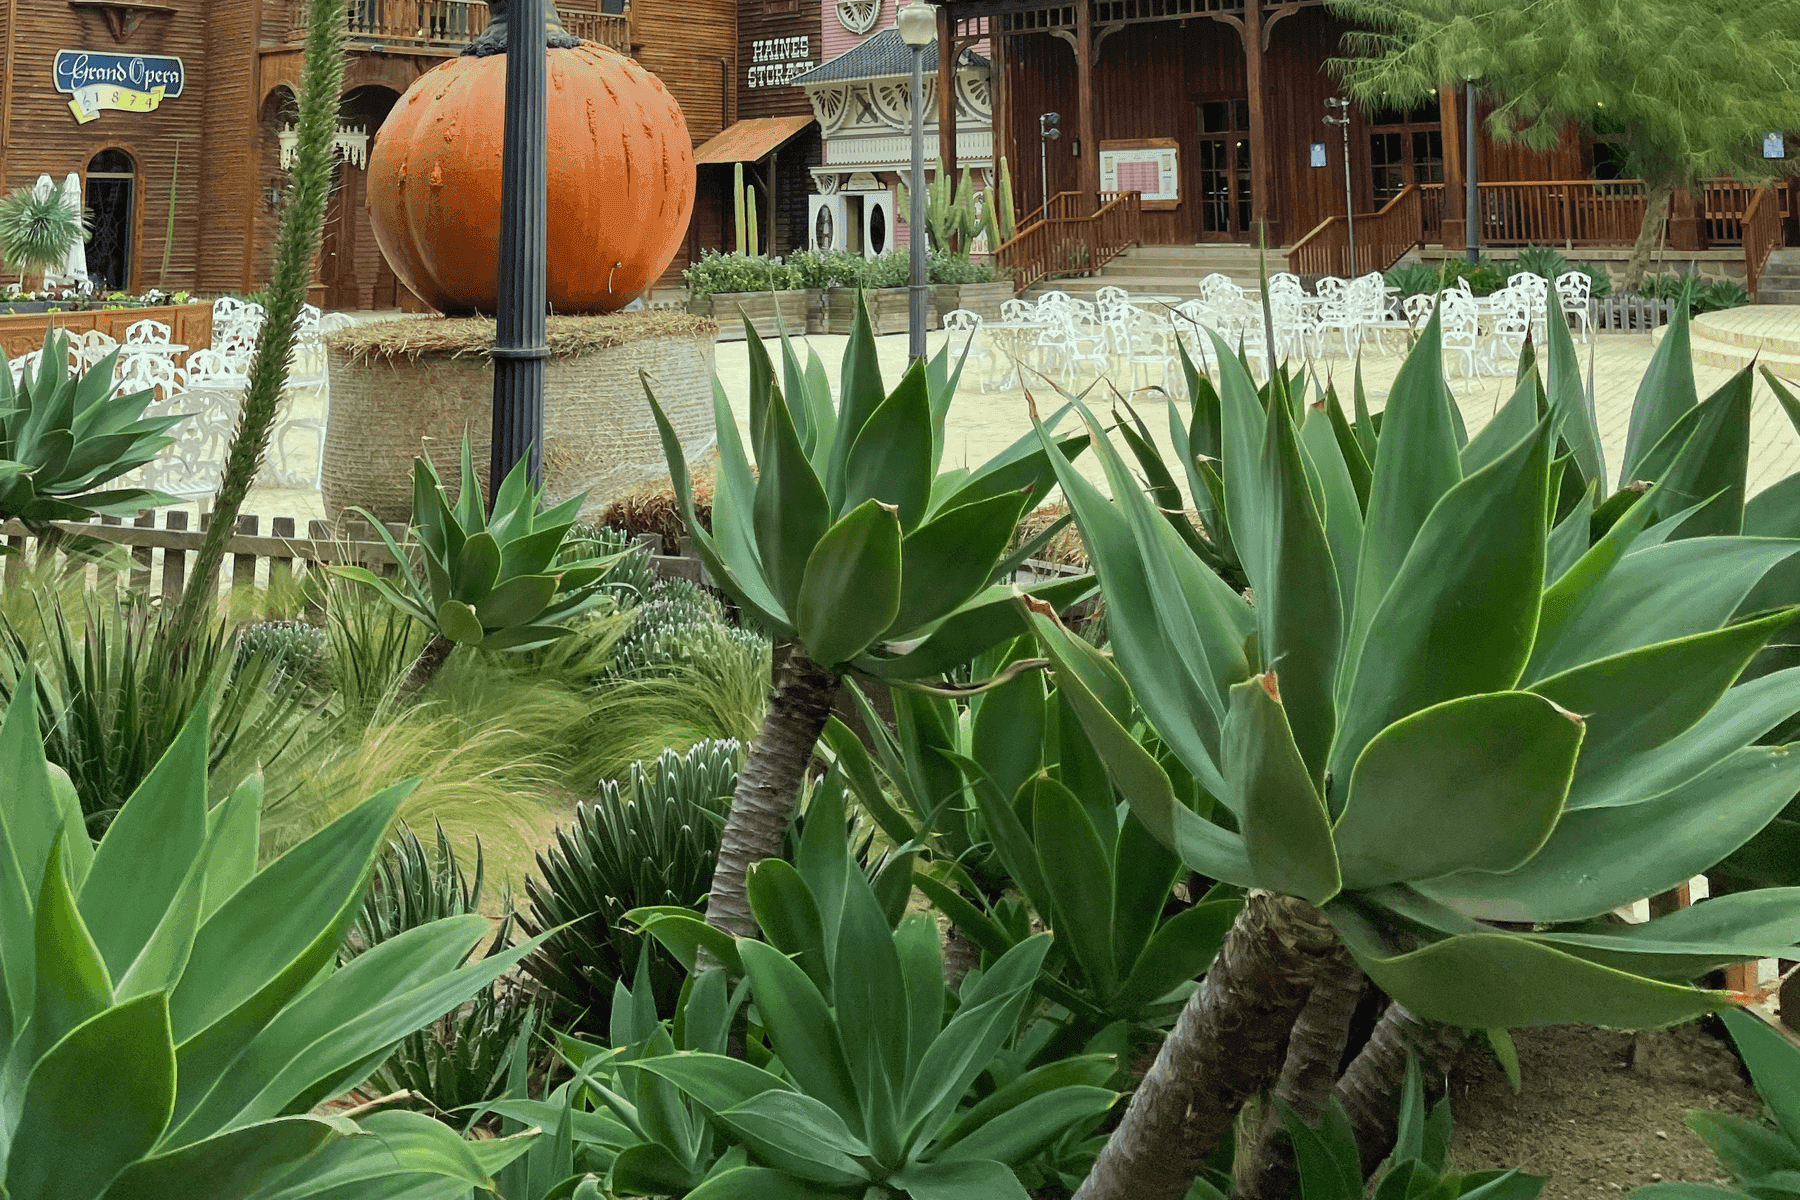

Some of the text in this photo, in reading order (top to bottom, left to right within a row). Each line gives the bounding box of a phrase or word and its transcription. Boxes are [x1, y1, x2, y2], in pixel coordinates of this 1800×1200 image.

[752, 35, 809, 62] HAINES
[58, 54, 180, 91] Grand Opera
